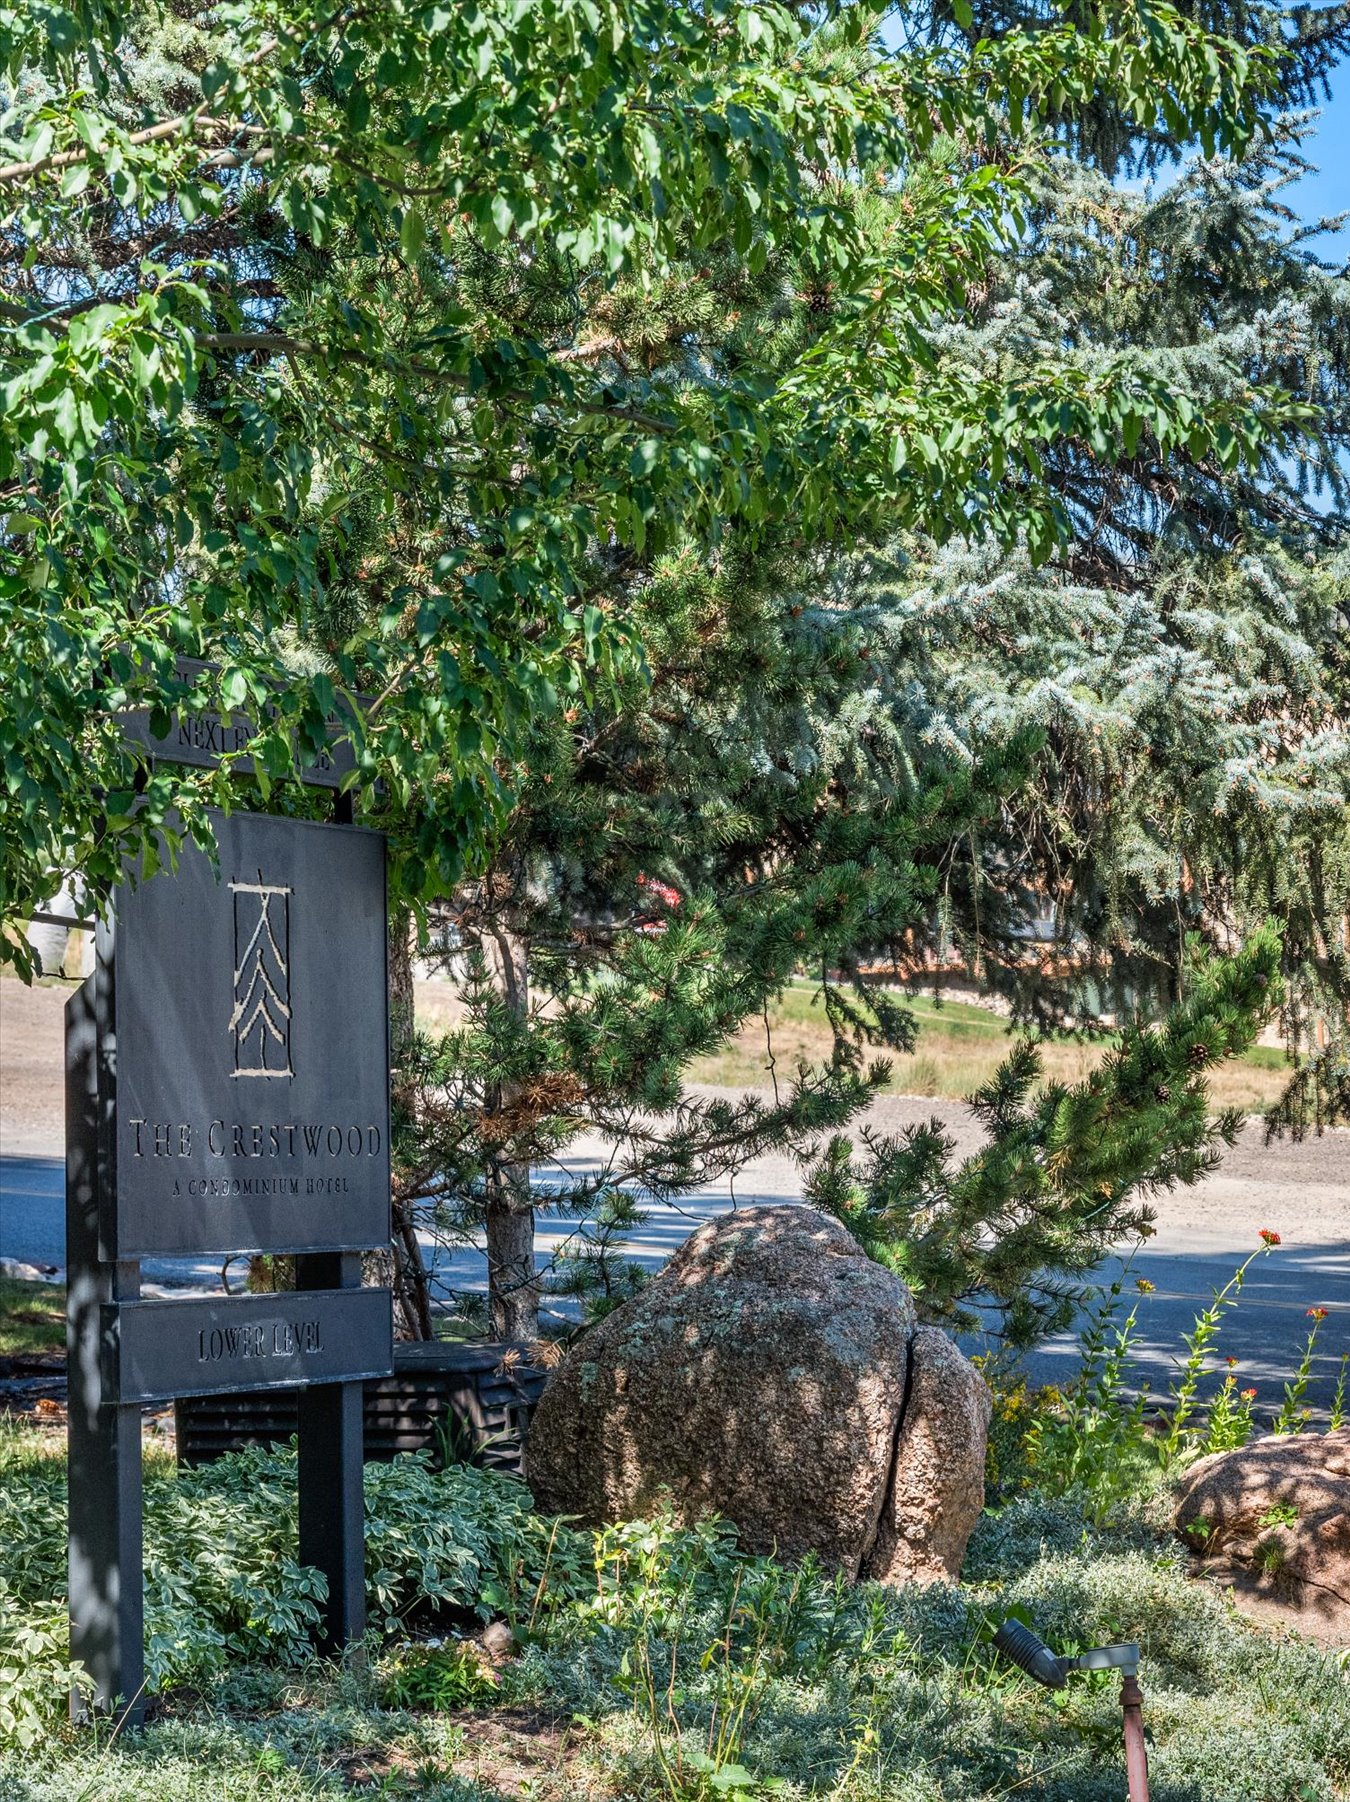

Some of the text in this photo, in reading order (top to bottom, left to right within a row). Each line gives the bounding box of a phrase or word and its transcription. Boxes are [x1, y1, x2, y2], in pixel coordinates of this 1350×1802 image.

[178, 717, 227, 752] NEXT
[129, 1119, 193, 1158] THE
[172, 1177, 350, 1197] A CONDOMINIUM HOTEL
[198, 1321, 325, 1362] LOWER LEVEL
